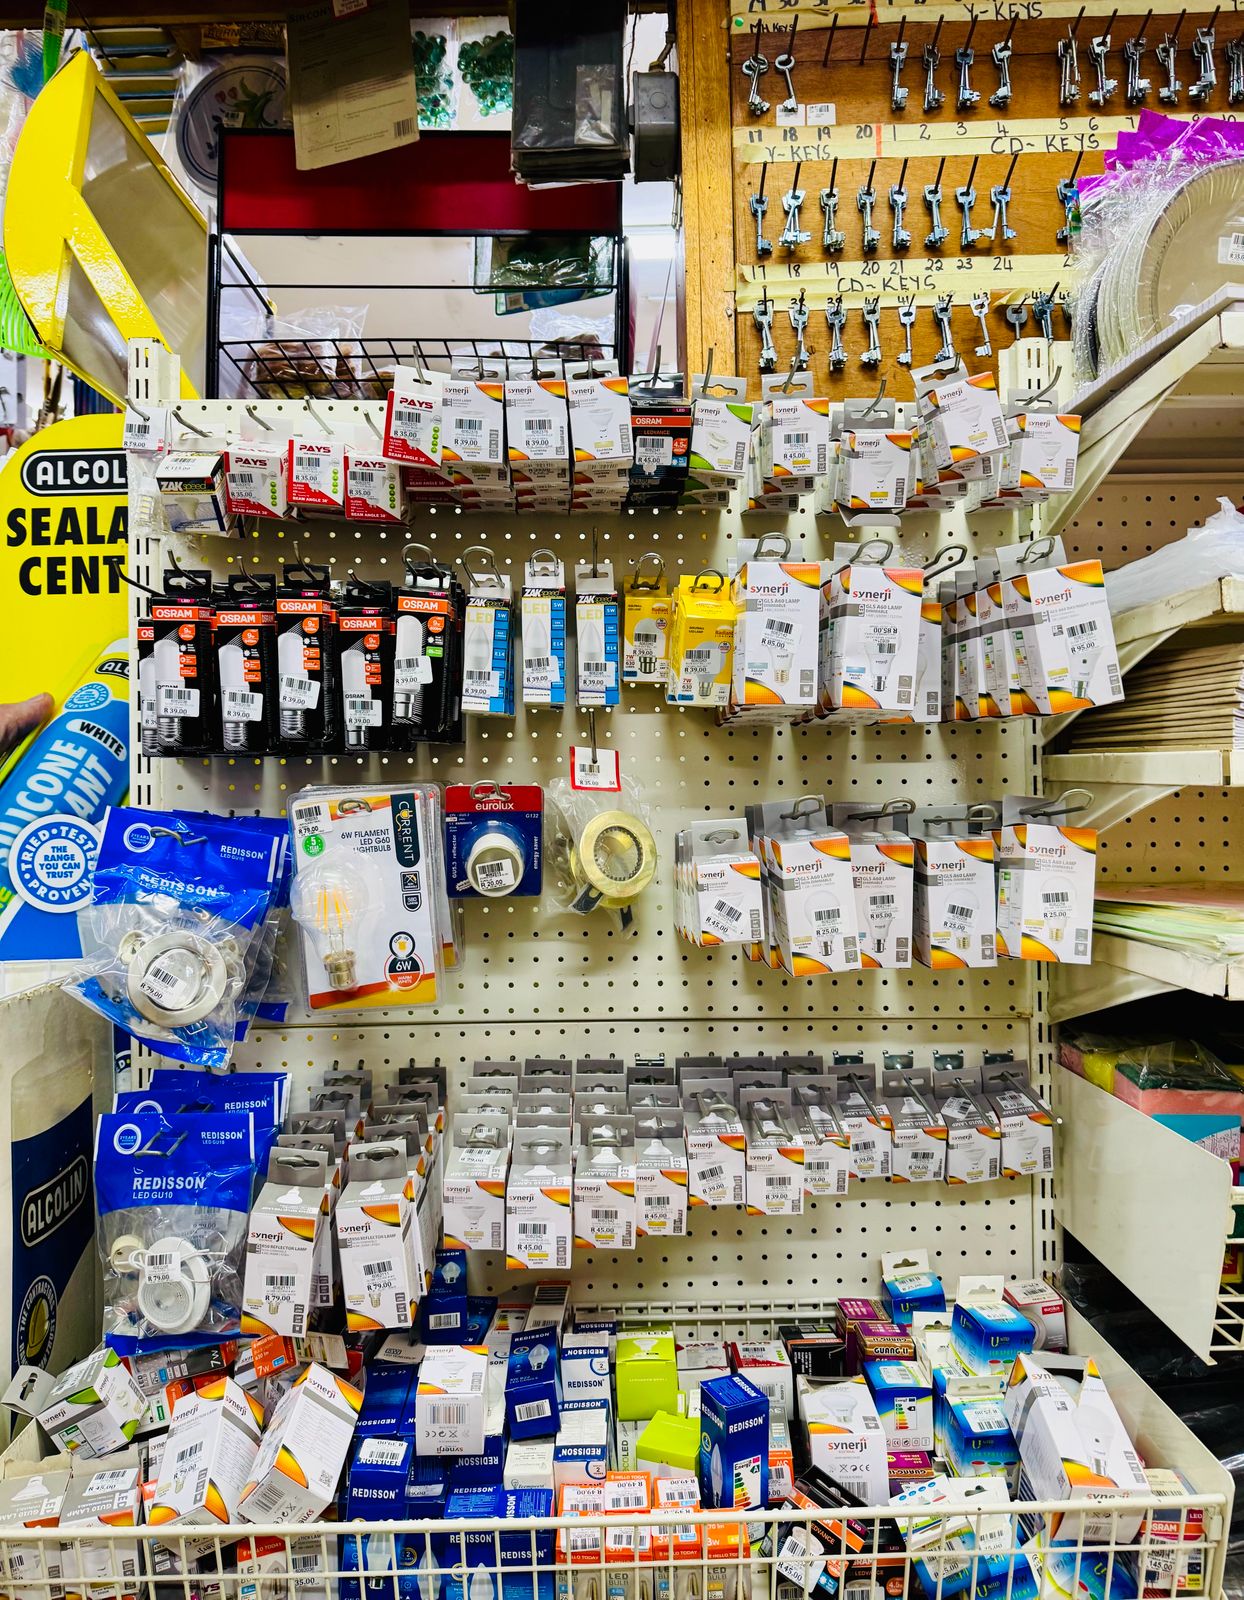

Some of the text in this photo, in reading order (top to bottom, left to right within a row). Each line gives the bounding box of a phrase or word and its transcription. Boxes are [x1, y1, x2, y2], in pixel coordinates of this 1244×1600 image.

[749, 129, 763, 143] 17
[783, 127, 798, 142] 18
[818, 128, 831, 140] 19
[856, 125, 873, 139] 20
[919, 124, 931, 140] 2
[956, 122, 968, 136] 3
[998, 122, 1009, 137] 4
[1060, 117, 1069, 130] 5
[1088, 117, 1099, 131] 6
[1126, 117, 1135, 129] 7
[752, 256, 1014, 280] 17 18 19 20 21 22 23 24
[445, 385, 470, 396] synerji
[508, 385, 532, 395] synerji
[572, 385, 596, 395] synerji
[400, 397, 434, 409] PAYS
[698, 407, 721, 416] synerji
[776, 406, 798, 415] synerji
[400, 430, 418, 439] 35.00
[299, 444, 332, 453] PAYS
[235, 457, 268, 467] PAYS
[355, 460, 387, 470] PAYS
[161, 481, 184, 492] ZAK
[19, 556, 125, 596] CENT
[750, 582, 790, 597] synerji
[853, 588, 891, 602] synerji
[1035, 588, 1073, 606] synerji
[280, 602, 317, 612] OSRAM
[403, 600, 439, 610] OSRAM
[156, 609, 192, 618] OSRAM
[220, 614, 256, 623] OSRAM
[343, 620, 377, 629] OSRAM
[767, 640, 785, 649] 85.00
[233, 711, 250, 719] 39.00
[79, 721, 126, 758] WHITE
[475, 801, 514, 811] eurolux
[354, 829, 389, 838] FILAMENT
[21, 829, 50, 872] TRIED
[221, 845, 264, 860] REDISSON
[1029, 845, 1066, 856] synerji
[44, 854, 76, 862] RANGE
[62, 862, 81, 870] CAN
[786, 858, 823, 874] synerji
[930, 859, 966, 871] synerji
[46, 870, 74, 879] TRUST
[700, 870, 725, 879] synerji
[487, 879, 503, 887] 20.00
[29, 878, 94, 901] PROVEN
[396, 961, 412, 971] 6W
[224, 1100, 268, 1110] REDISSON
[201, 1131, 243, 1140] REDISSON
[133, 1175, 205, 1190] REDISSON
[152, 1191, 173, 1199] GU10
[509, 1193, 535, 1203] synerji
[28, 1171, 83, 1236] ALCOLIN
[339, 1221, 371, 1233] synerji
[251, 1230, 285, 1241] synerji
[373, 1282, 392, 1290] 79.00
[515, 1332, 550, 1342] REDISSON
[210, 1349, 221, 1368] 7W
[257, 1365, 270, 1376] 7W
[307, 1377, 336, 1399] synerji
[568, 1379, 604, 1388] REDISSON
[563, 1401, 601, 1409] REDISSON
[729, 1416, 763, 1434] REDISSON
[828, 1437, 867, 1451] synerji
[561, 1447, 602, 1455] REDISSON
[458, 1456, 499, 1467] REDISSON
[734, 1461, 751, 1471] Energy
[352, 1487, 395, 1500] REDISSON
[852, 1521, 862, 1532] LED
[1149, 1560, 1173, 1571] 145.00
[708, 1567, 727, 1575] LED
[784, 1565, 803, 1582] 45.00
